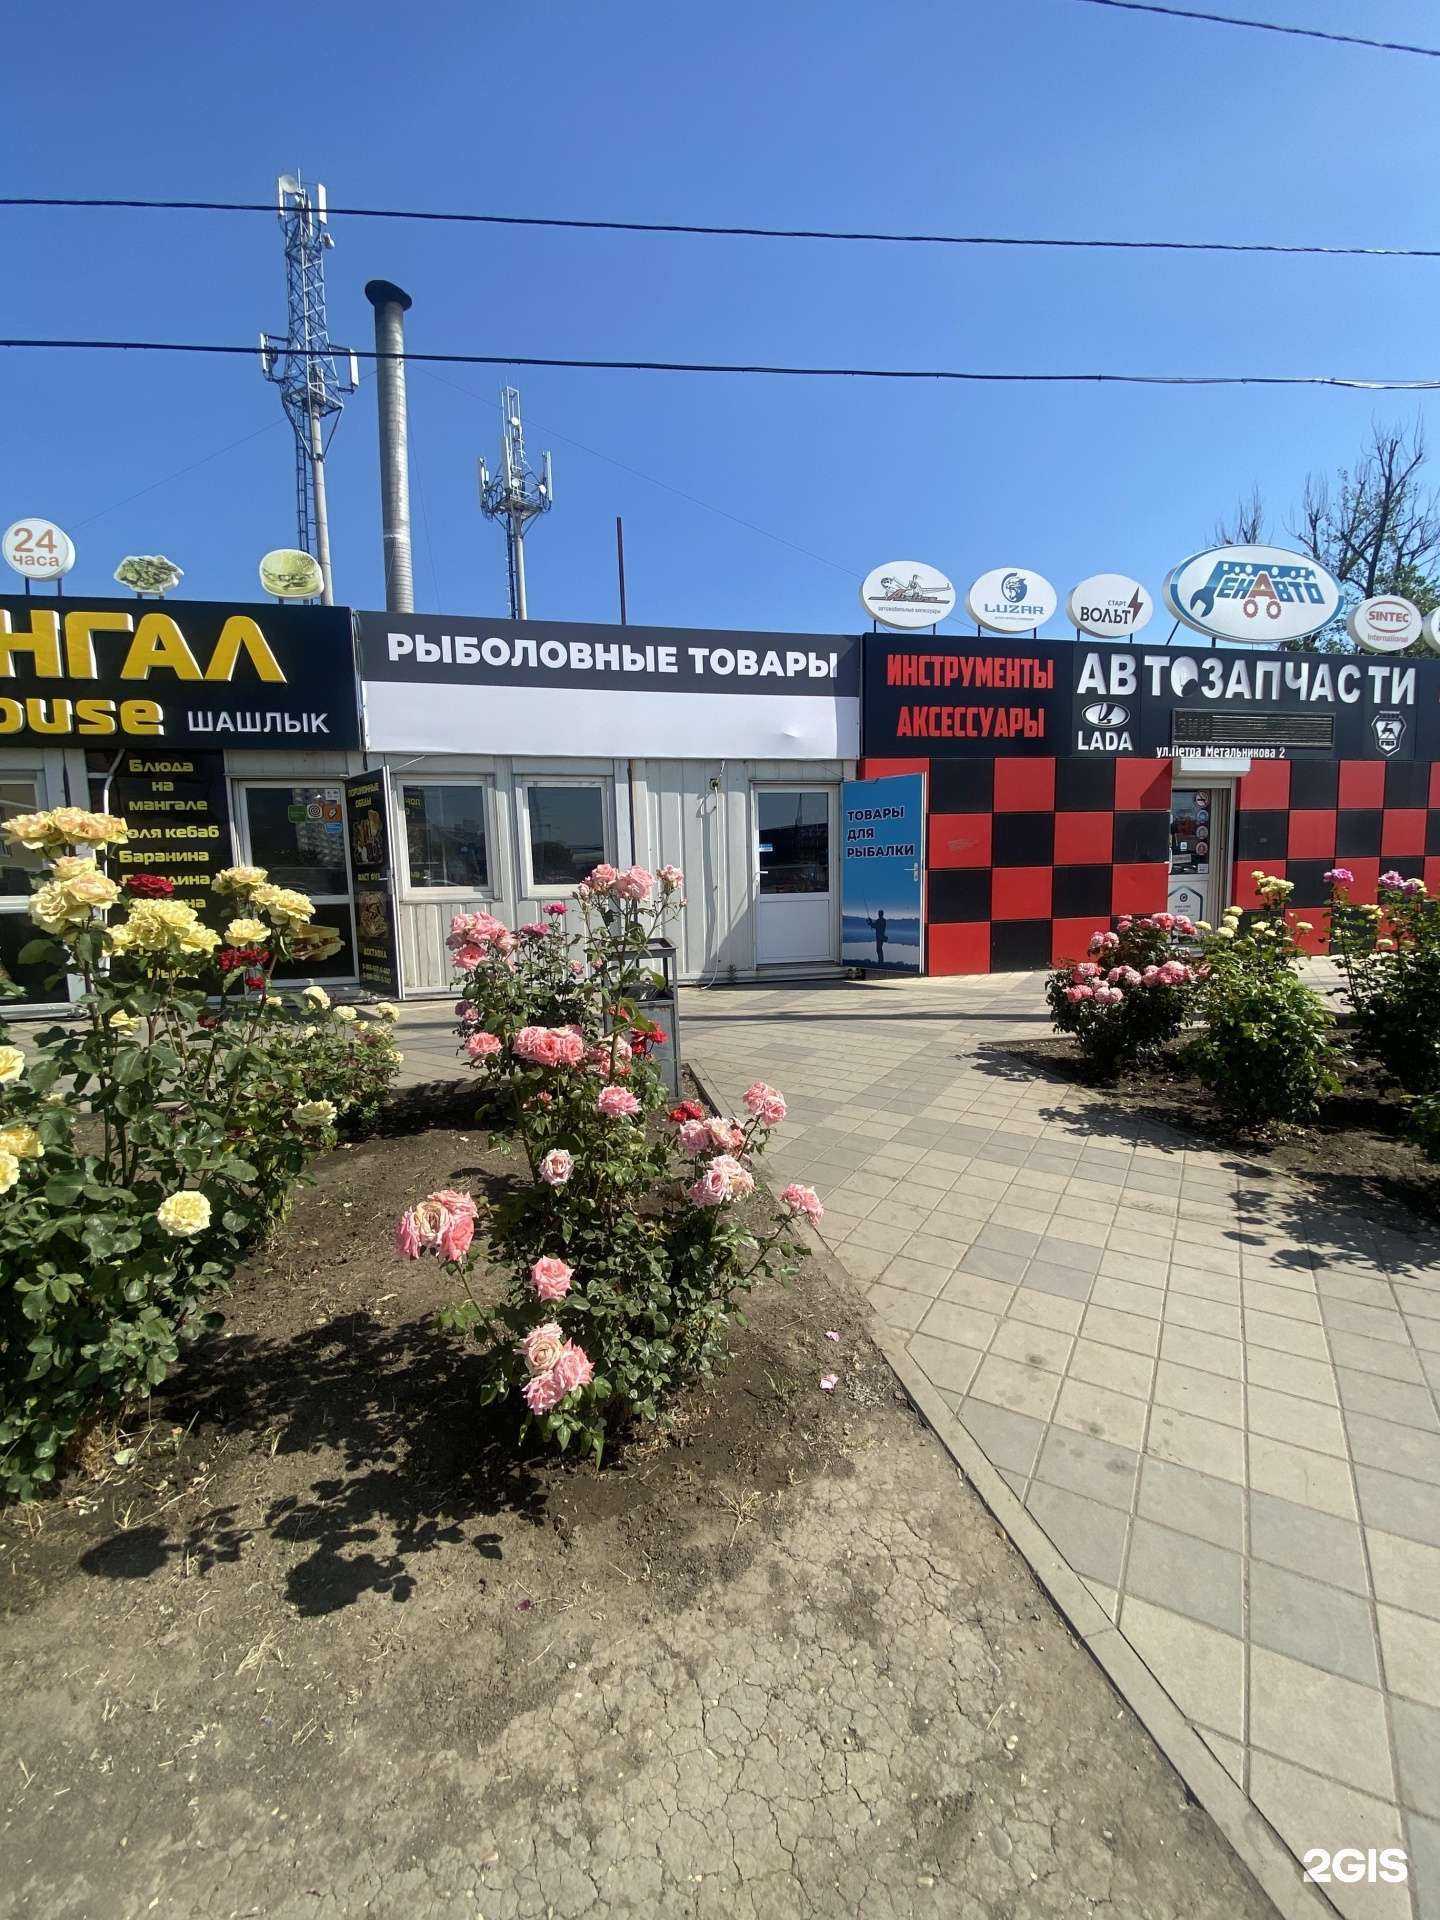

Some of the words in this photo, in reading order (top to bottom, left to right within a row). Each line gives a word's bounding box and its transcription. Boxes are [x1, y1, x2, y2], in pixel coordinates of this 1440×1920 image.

[14, 527, 57, 554] 24
[12, 554, 60, 567] часа
[984, 603, 1044, 615] LUZAR
[1080, 607, 1131, 624] ВОЛЬТ
[1368, 610, 1409, 622] SINTEC
[387, 632, 678, 674] РЫБОЛОВНЫЕ
[688, 647, 838, 678] ТОВАРЫ
[887, 654, 1054, 689] ИНСТРУМЕНТЫ
[187, 710, 330, 733] ШАШЛЫК
[896, 706, 1045, 738] АКСЕССУАРЫ
[1077, 731, 1133, 751] LADA
[1205, 746, 1276, 758] Метальникова
[1279, 747, 1286, 758] 2
[129, 759, 194, 772] Блюда
[152, 781, 174, 792] на
[129, 800, 208, 811] мангале
[848, 806, 904, 821] ТОВАРЫ
[165, 825, 219, 838] кебаб
[848, 828, 874, 841] ДЛЯ
[119, 850, 209, 865] Баранина
[847, 844, 914, 858] РЫБАЛКИ
